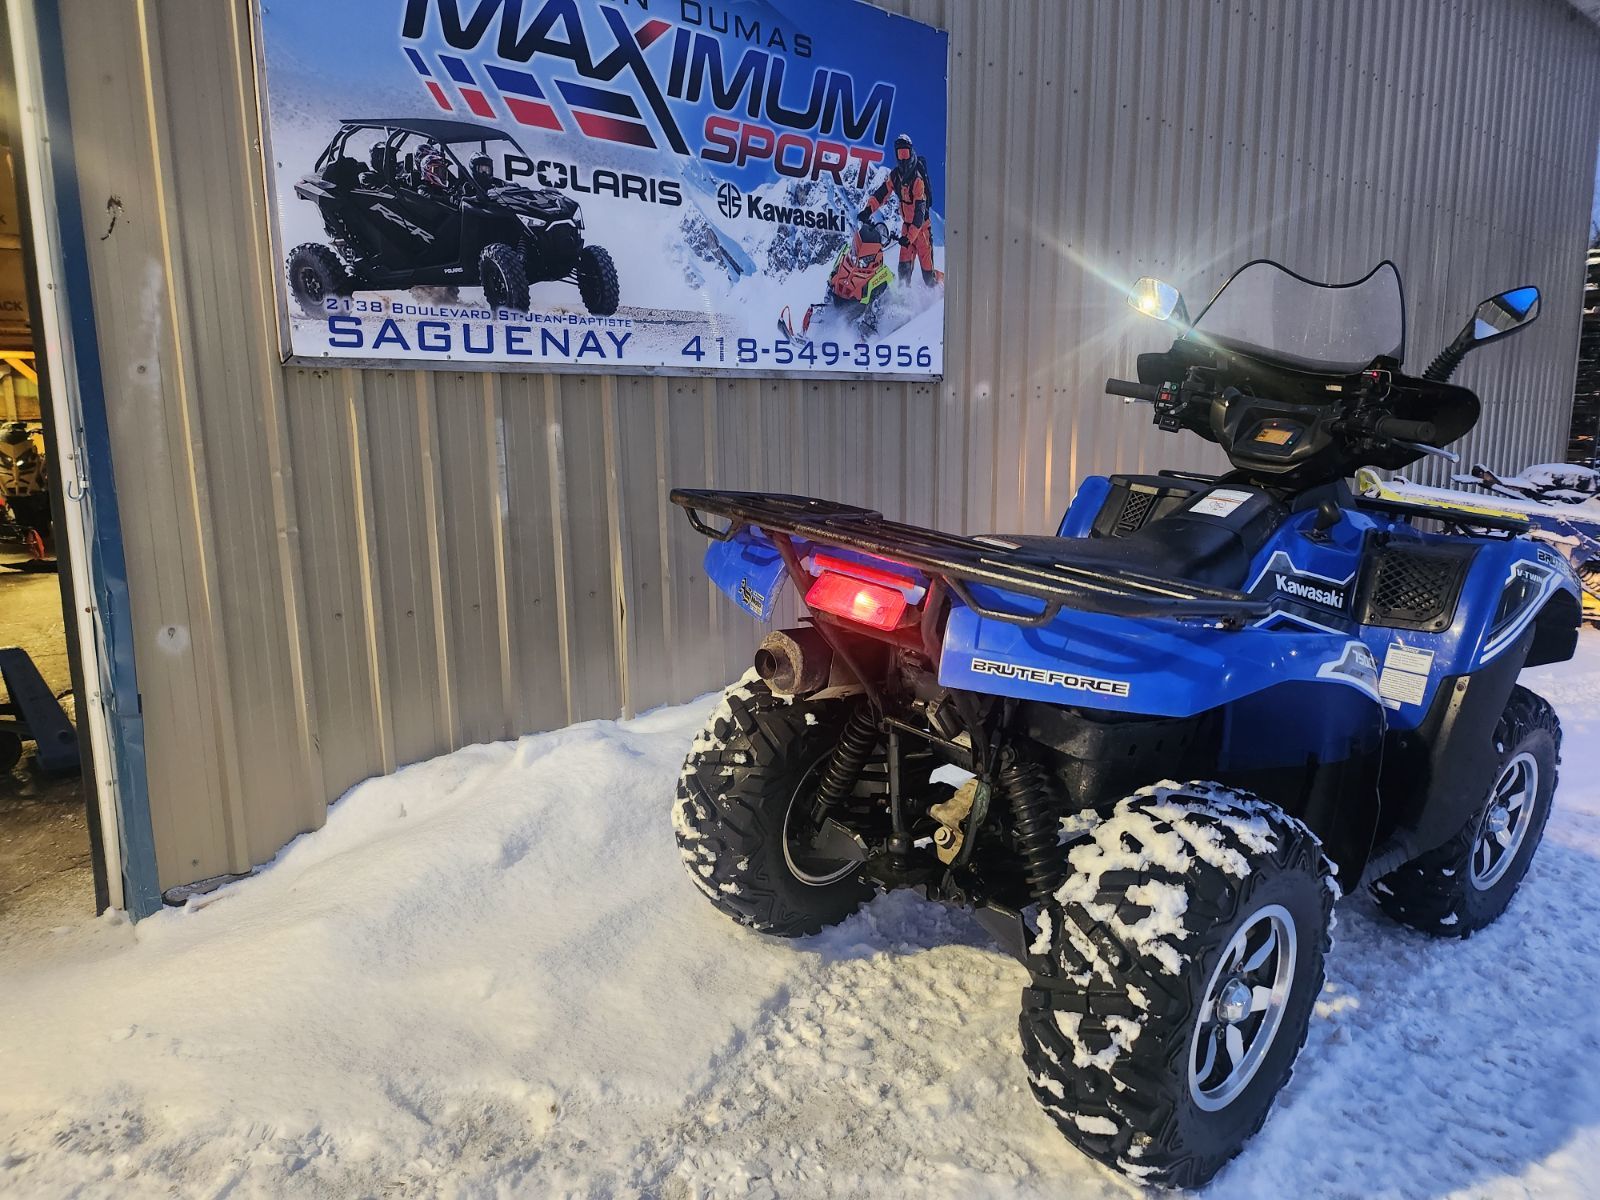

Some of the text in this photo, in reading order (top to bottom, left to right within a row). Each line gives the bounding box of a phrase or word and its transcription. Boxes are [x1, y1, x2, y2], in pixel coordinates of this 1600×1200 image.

[680, 0, 812, 58] DUMAS
[402, 0, 896, 156] MAXIMUM
[701, 117, 883, 189] SPORT
[503, 153, 683, 207] POLARIS
[747, 194, 846, 232] Kawasaki
[326, 298, 383, 313] 2138
[392, 303, 491, 320] BOULEVARD
[328, 315, 633, 359] SAGUENAY
[1275, 573, 1344, 609] Kawasaki
[972, 659, 1128, 695] BRUTE FORCE
